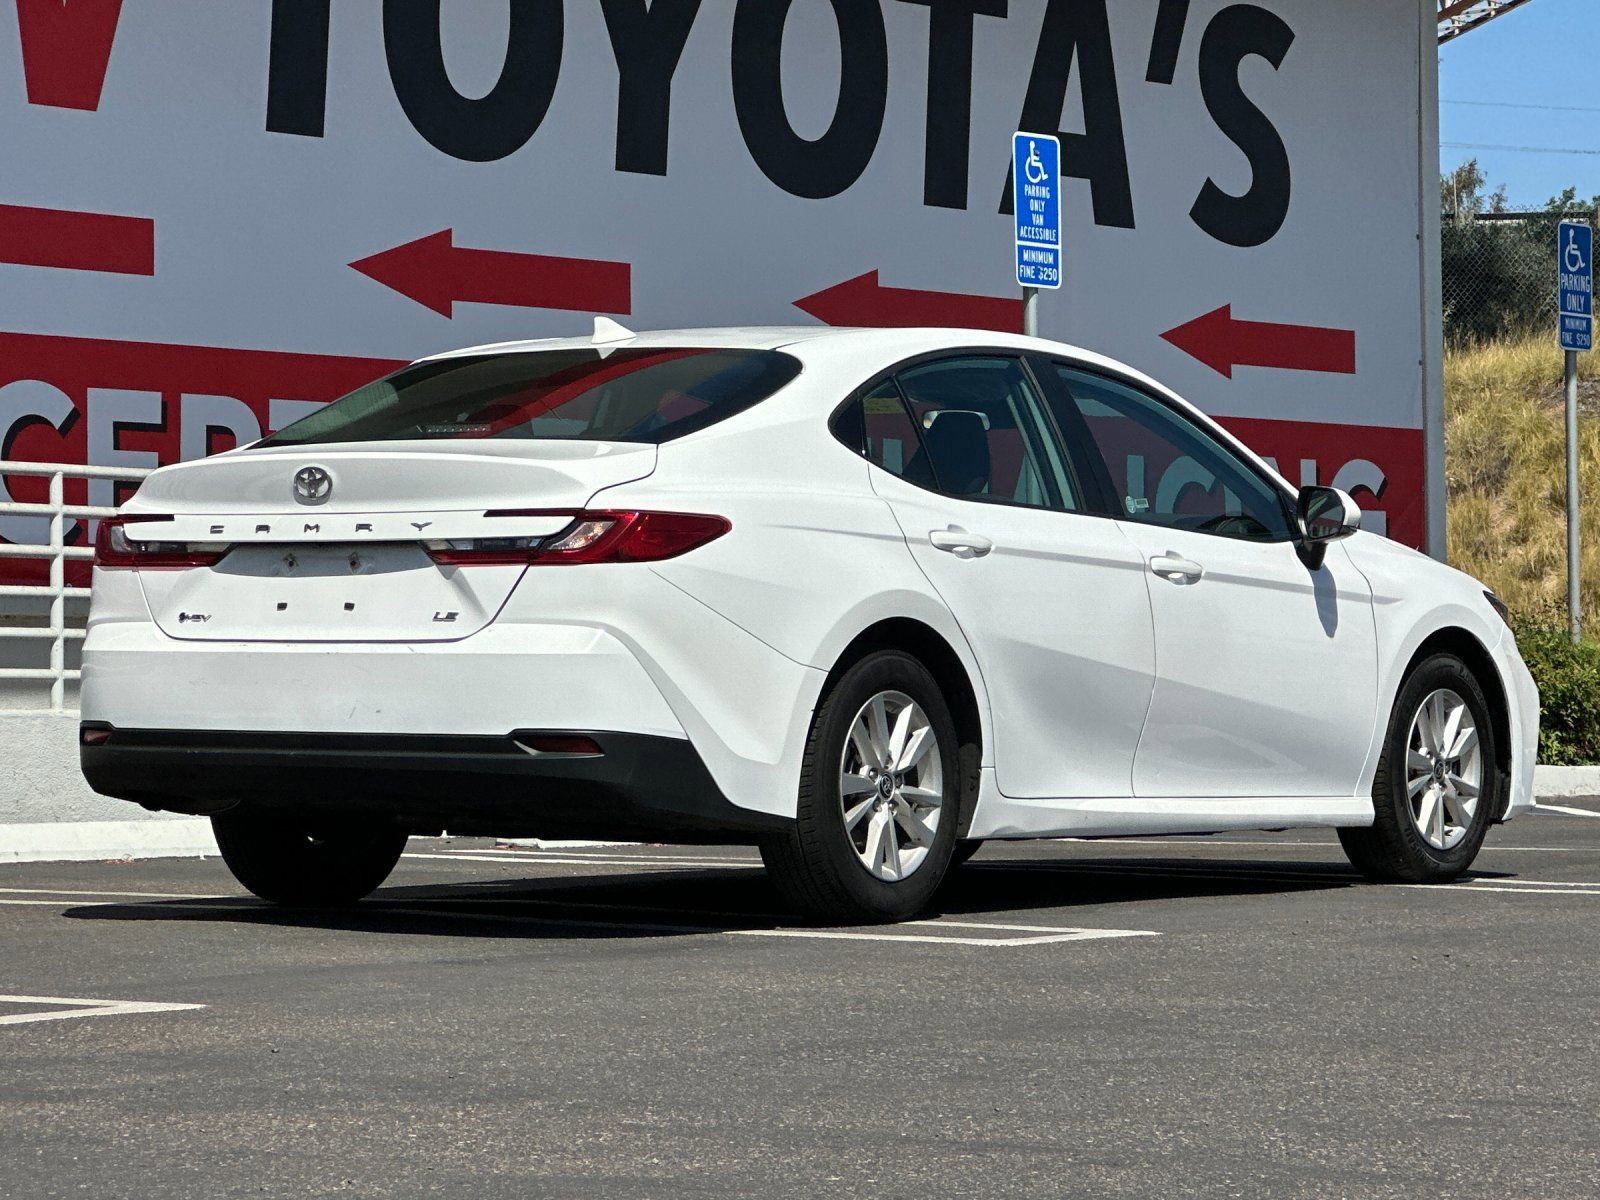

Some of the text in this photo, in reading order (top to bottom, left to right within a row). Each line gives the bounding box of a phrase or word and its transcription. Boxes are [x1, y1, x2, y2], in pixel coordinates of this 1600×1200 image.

[1024, 184, 1050, 199] PARKING
[1029, 199, 1045, 212] ONLY
[1031, 213, 1044, 226] VAN
[1019, 226, 1056, 241] ACCESSIBLE
[1022, 249, 1053, 264] MINIMUM
[1019, 265, 1057, 281] FINE $250
[1560, 273, 1591, 293] PARKING
[1566, 293, 1585, 312] ONLY
[1561, 331, 1590, 346] FINE $250
[209, 522, 433, 534] CAMRY
[432, 611, 460, 622] LE
